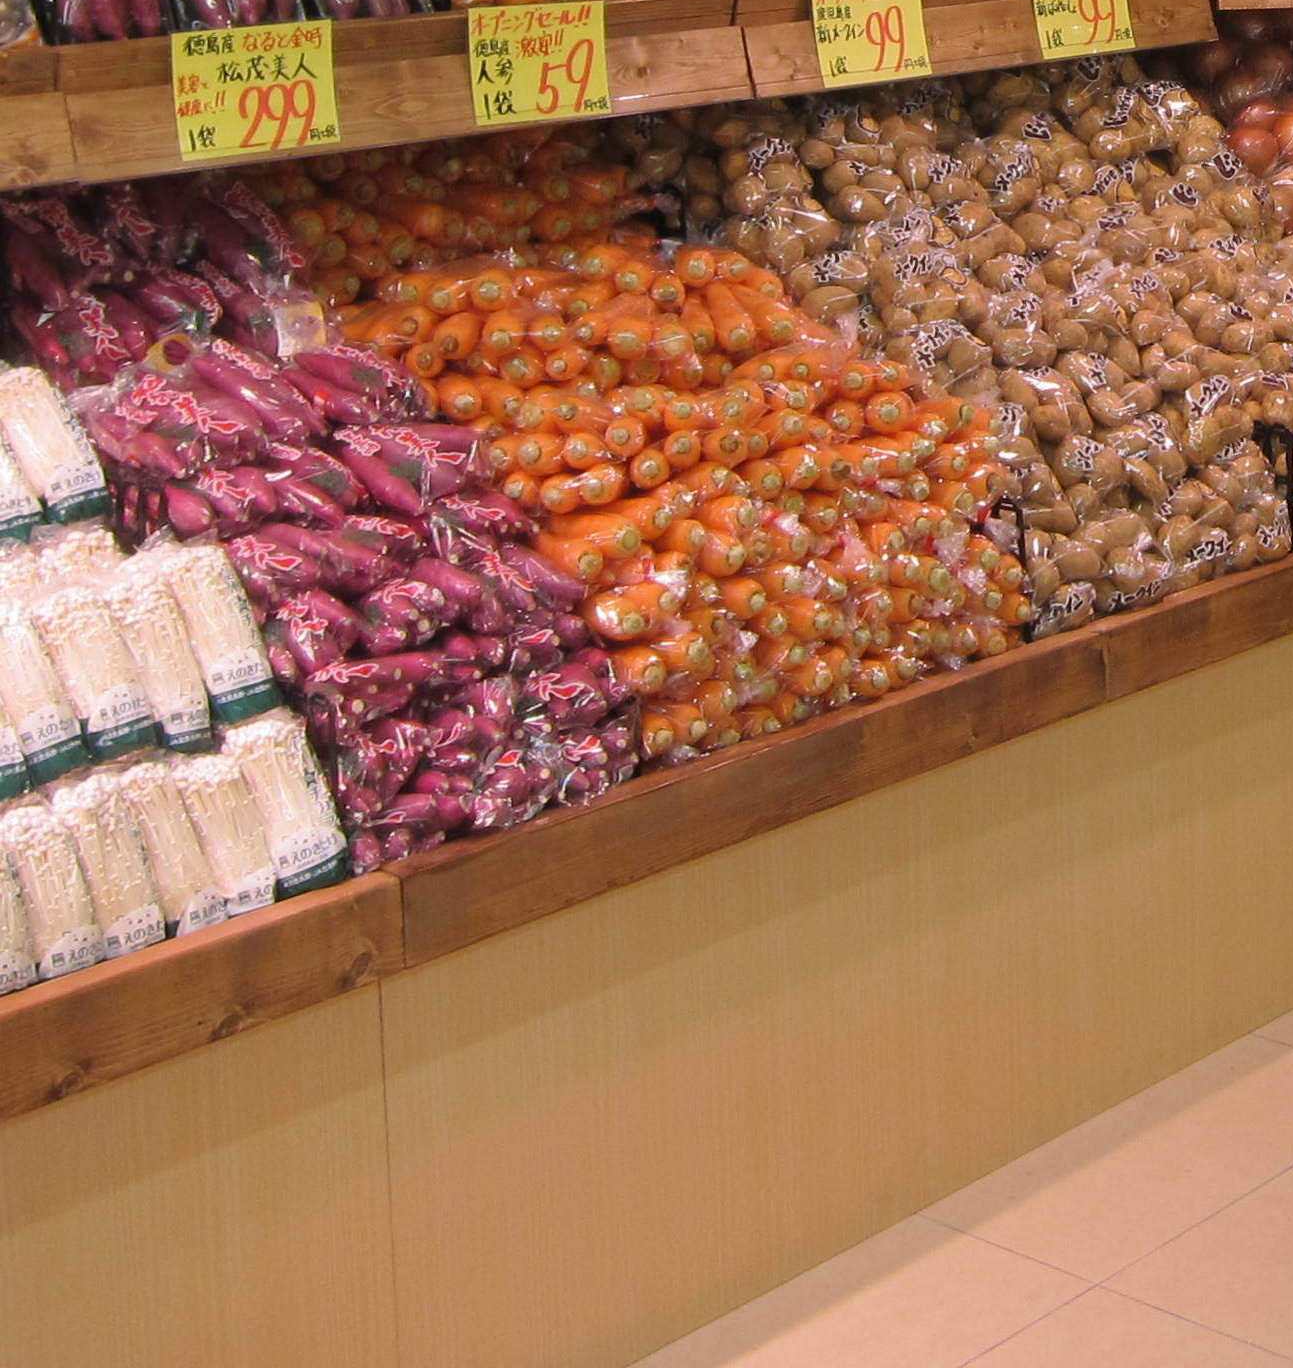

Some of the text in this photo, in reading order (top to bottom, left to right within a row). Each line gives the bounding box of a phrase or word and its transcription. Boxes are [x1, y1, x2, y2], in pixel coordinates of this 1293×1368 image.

[183, 26, 323, 56] 徳島産 なると金時
[866, 5, 904, 72] 99
[477, 58, 515, 85] 人参
[536, 38, 594, 114] 59
[238, 79, 316, 150] 299
[484, 90, 517, 120] 1袋
[189, 125, 216, 151] 1袋
